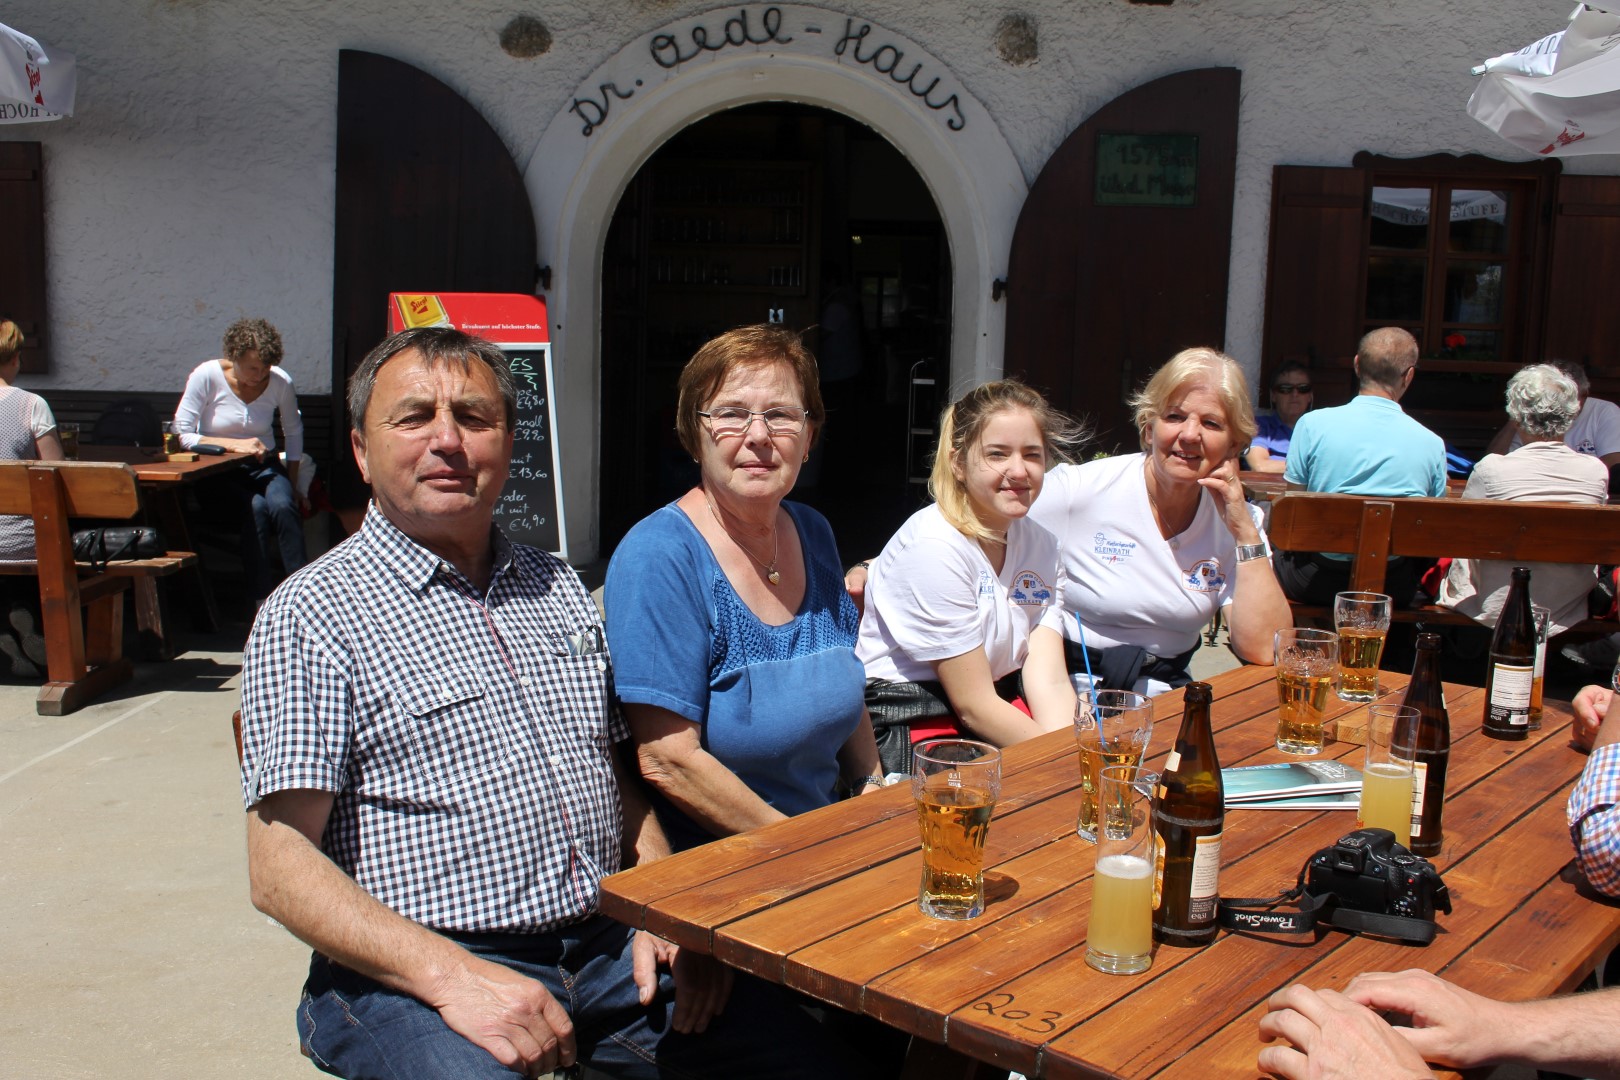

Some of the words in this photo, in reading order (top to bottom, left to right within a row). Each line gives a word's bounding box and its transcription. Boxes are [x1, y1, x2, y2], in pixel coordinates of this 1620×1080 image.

[569, 82, 644, 138] Dr.
[509, 514, 545, 531] €4,90
[1094, 546, 1130, 556] KLEINRATH
[1234, 913, 1297, 929] PowerShot
[973, 993, 1063, 1033] 203
